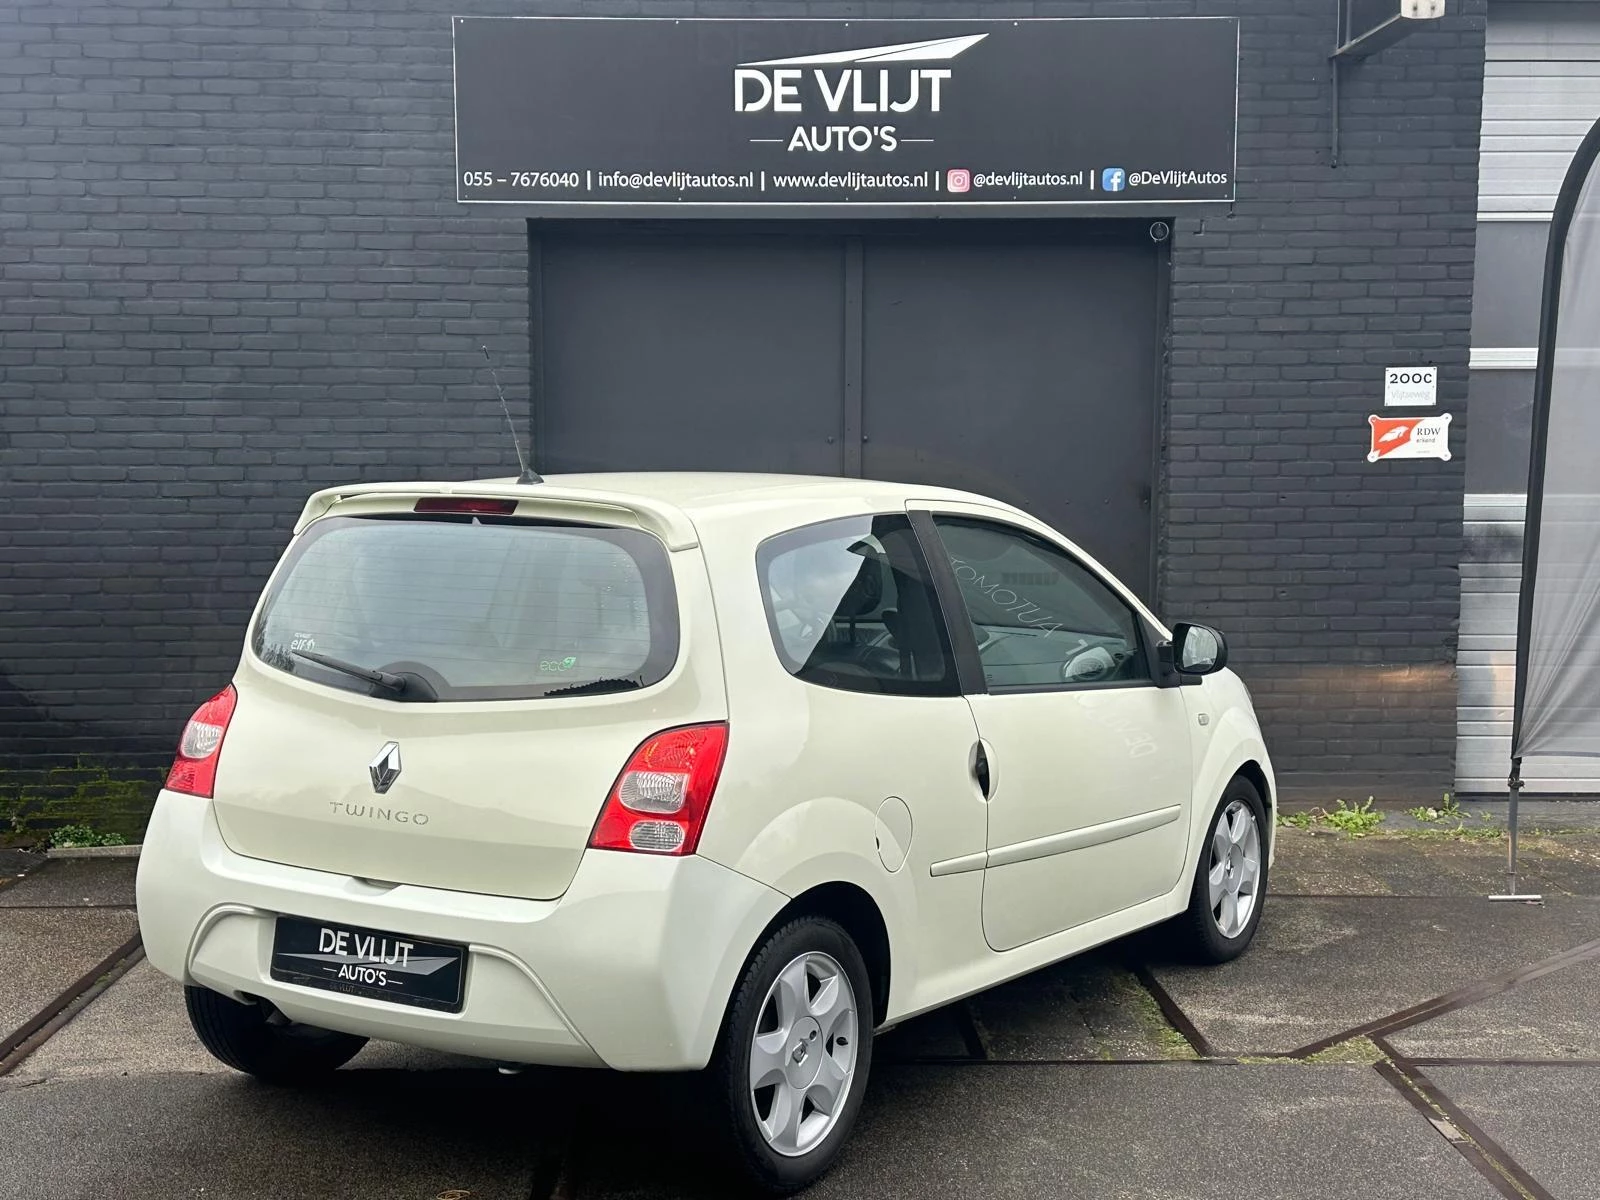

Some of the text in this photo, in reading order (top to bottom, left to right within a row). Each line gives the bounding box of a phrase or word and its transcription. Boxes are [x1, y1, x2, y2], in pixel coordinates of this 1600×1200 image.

[734, 69, 952, 113] DE VLIJT
[787, 126, 898, 151] AUTO'S
[463, 171, 493, 187] 055
[510, 171, 580, 187] 7676040
[598, 171, 754, 190] info@devlijtautos.nl
[772, 171, 928, 190] www.devlijtautos.nl
[973, 171, 1083, 188] @devlijtautos.nl
[1128, 171, 1228, 187] @DeVlijtAutos
[1416, 427, 1441, 436] RDW
[329, 801, 429, 825] TWINGO
[318, 928, 414, 967] DE VLIJT
[338, 964, 387, 986] AUTO'S
